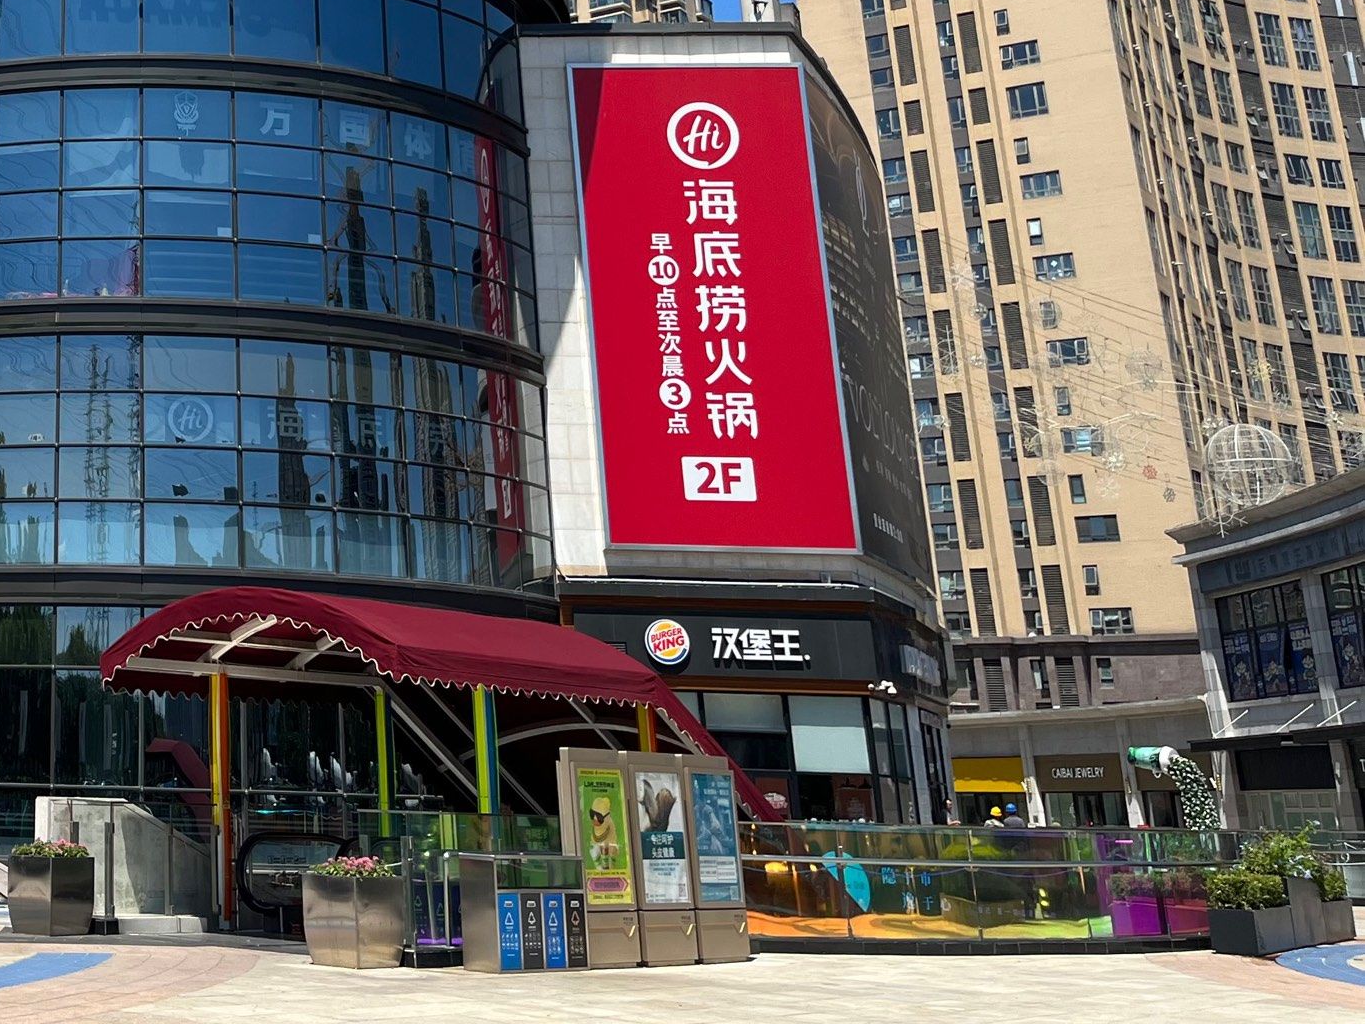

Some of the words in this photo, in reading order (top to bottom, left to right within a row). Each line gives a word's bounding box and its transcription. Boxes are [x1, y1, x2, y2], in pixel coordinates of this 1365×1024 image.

[682, 178, 759, 440] 海底捞火锅
[696, 461, 743, 495] 2F
[650, 627, 683, 642] BURGER
[653, 635, 685, 654] KING
[1075, 766, 1104, 778] JEWELRY
